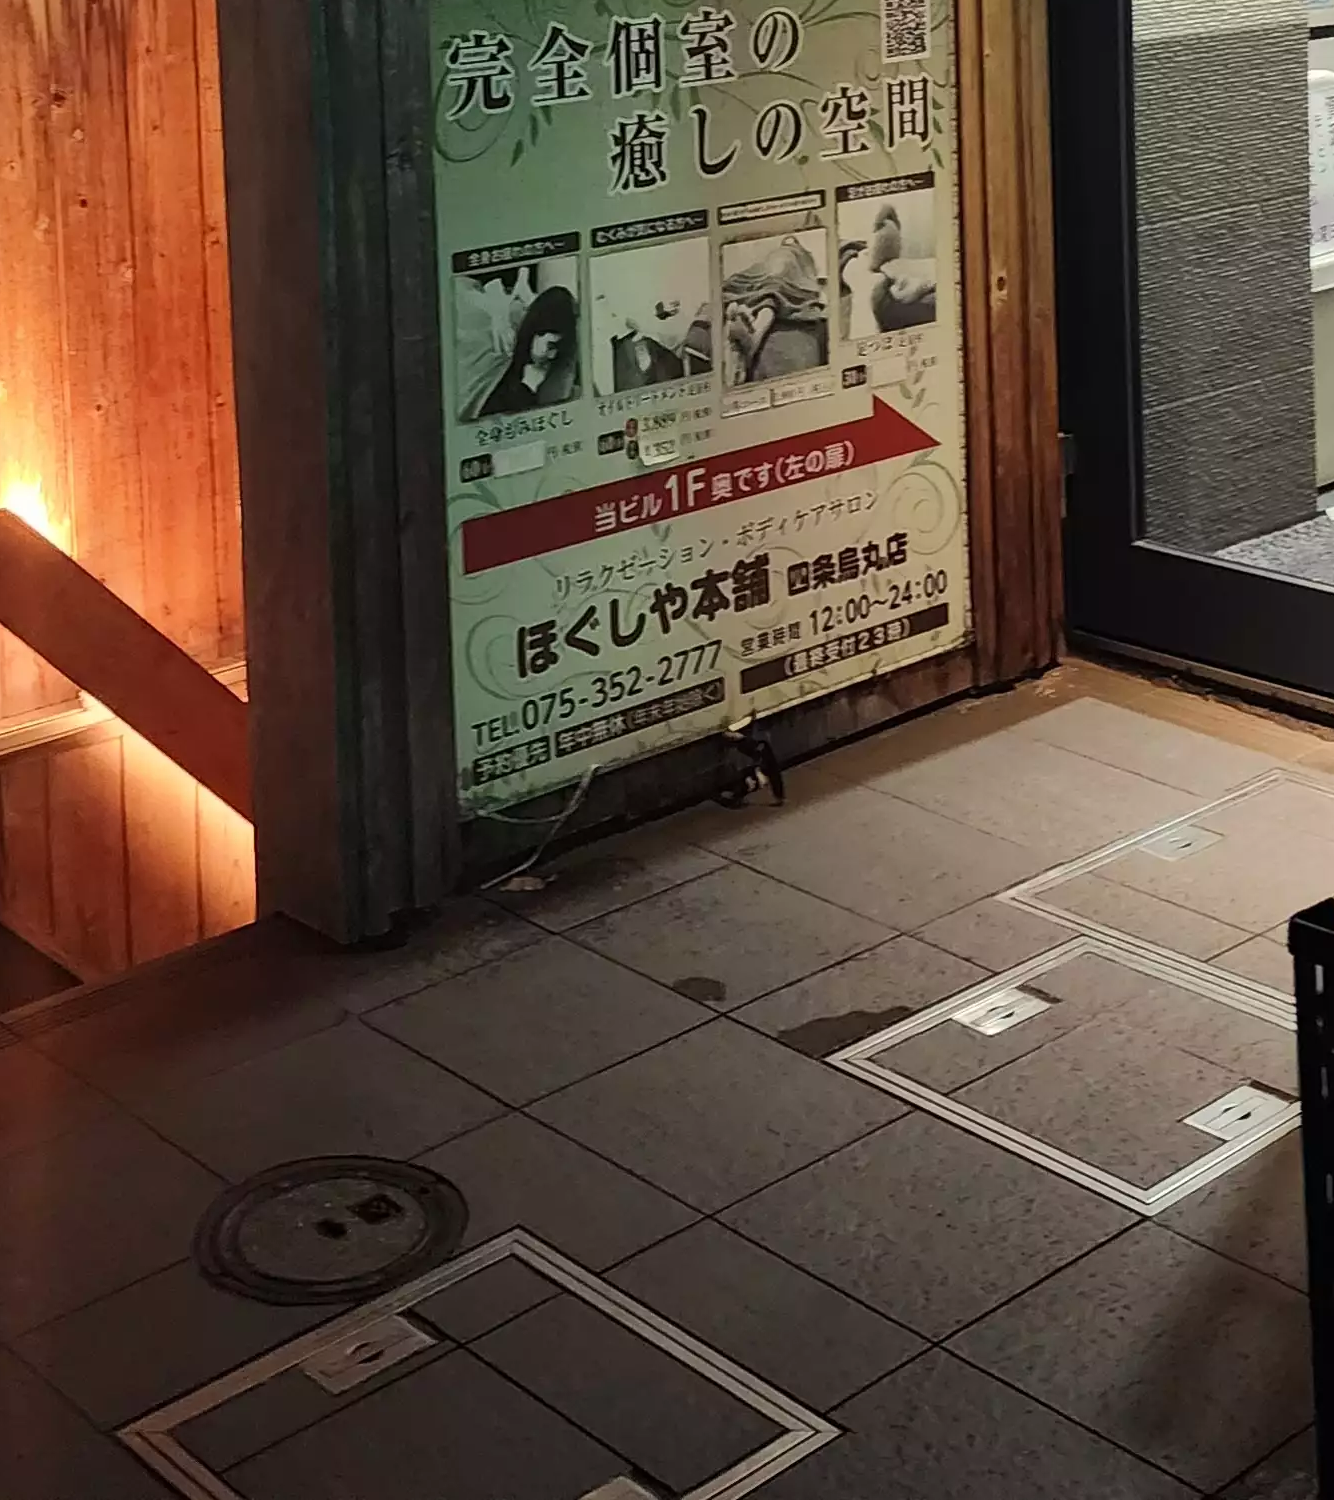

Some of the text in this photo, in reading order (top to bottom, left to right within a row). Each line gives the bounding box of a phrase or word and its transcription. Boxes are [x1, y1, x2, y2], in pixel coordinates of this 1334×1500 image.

[446, 8, 804, 122] 完全個室の
[608, 73, 935, 195] 癒しの空間
[517, 533, 909, 678] ほぐしや本舗 四条烏丸店
